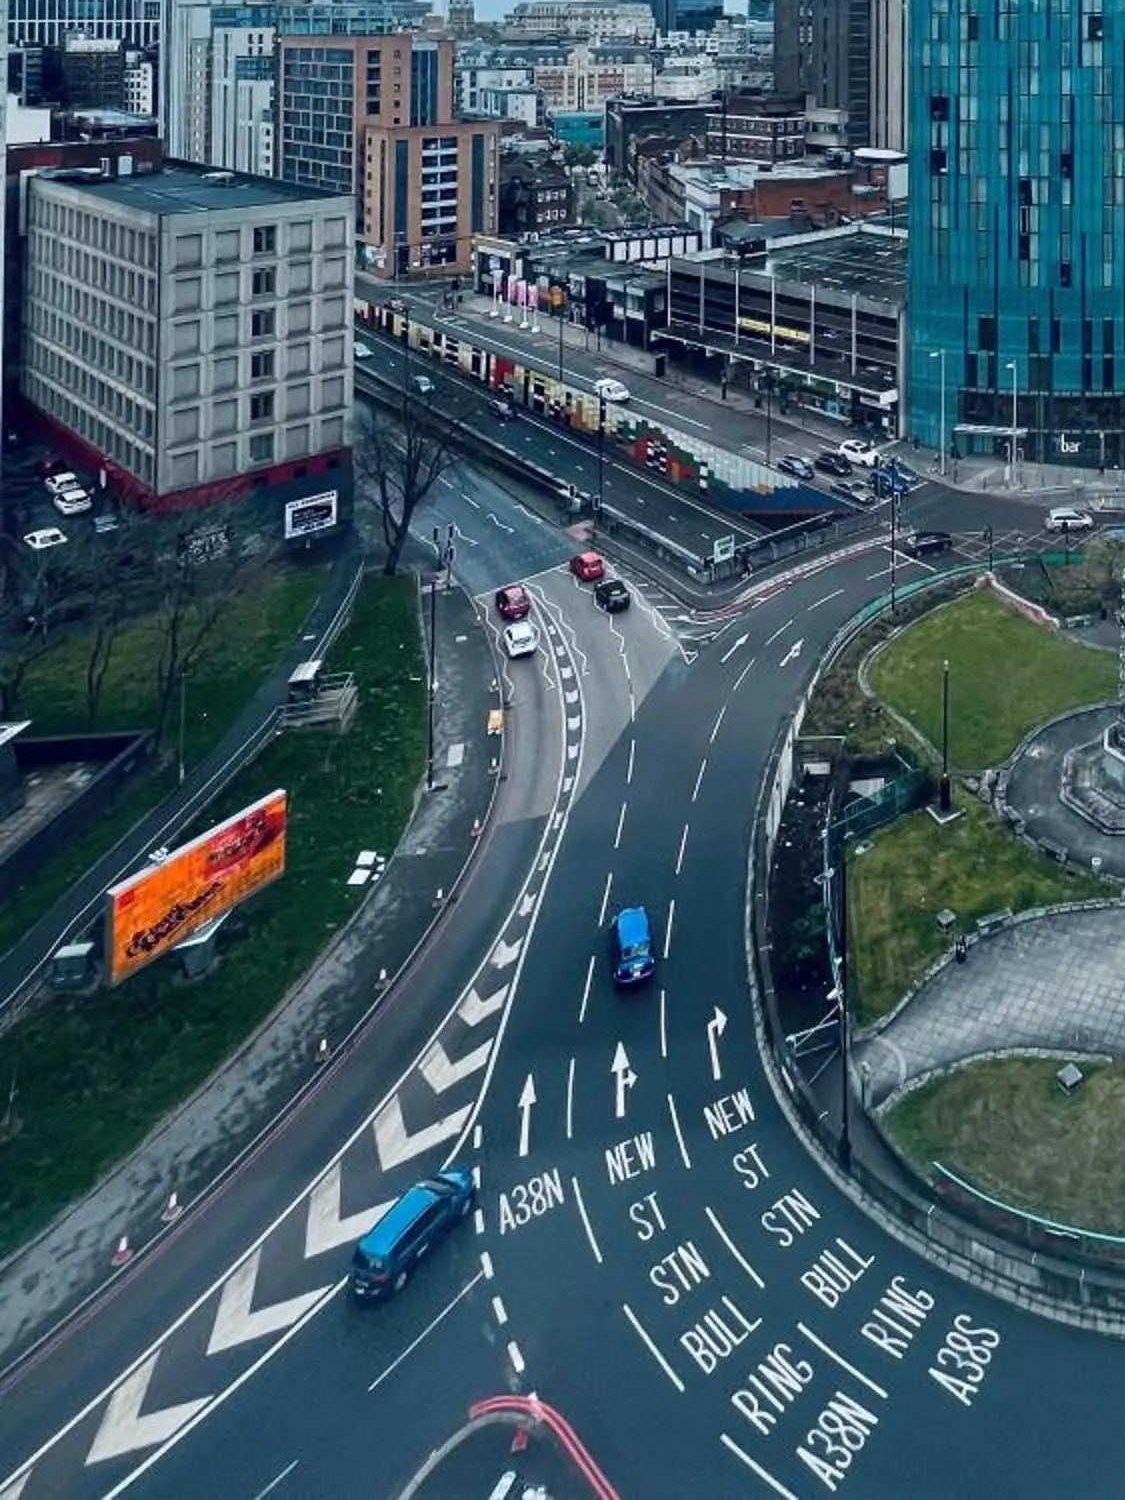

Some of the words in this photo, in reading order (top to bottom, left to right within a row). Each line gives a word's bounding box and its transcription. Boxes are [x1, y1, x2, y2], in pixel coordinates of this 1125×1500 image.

[704, 1089, 756, 1140] NEW
[605, 1132, 656, 1185] NEW
[733, 1144, 770, 1190] ST
[499, 1169, 565, 1235] A38N
[629, 1192, 666, 1241] ST
[761, 1188, 821, 1248] STN
[650, 1241, 711, 1305] STN
[801, 1238, 875, 1309] BULL
[680, 1296, 763, 1375] BULL
[861, 1275, 935, 1359] RING
[731, 1343, 814, 1435] RING
[928, 1314, 1000, 1406] A38S
[796, 1391, 879, 1492] A38N
